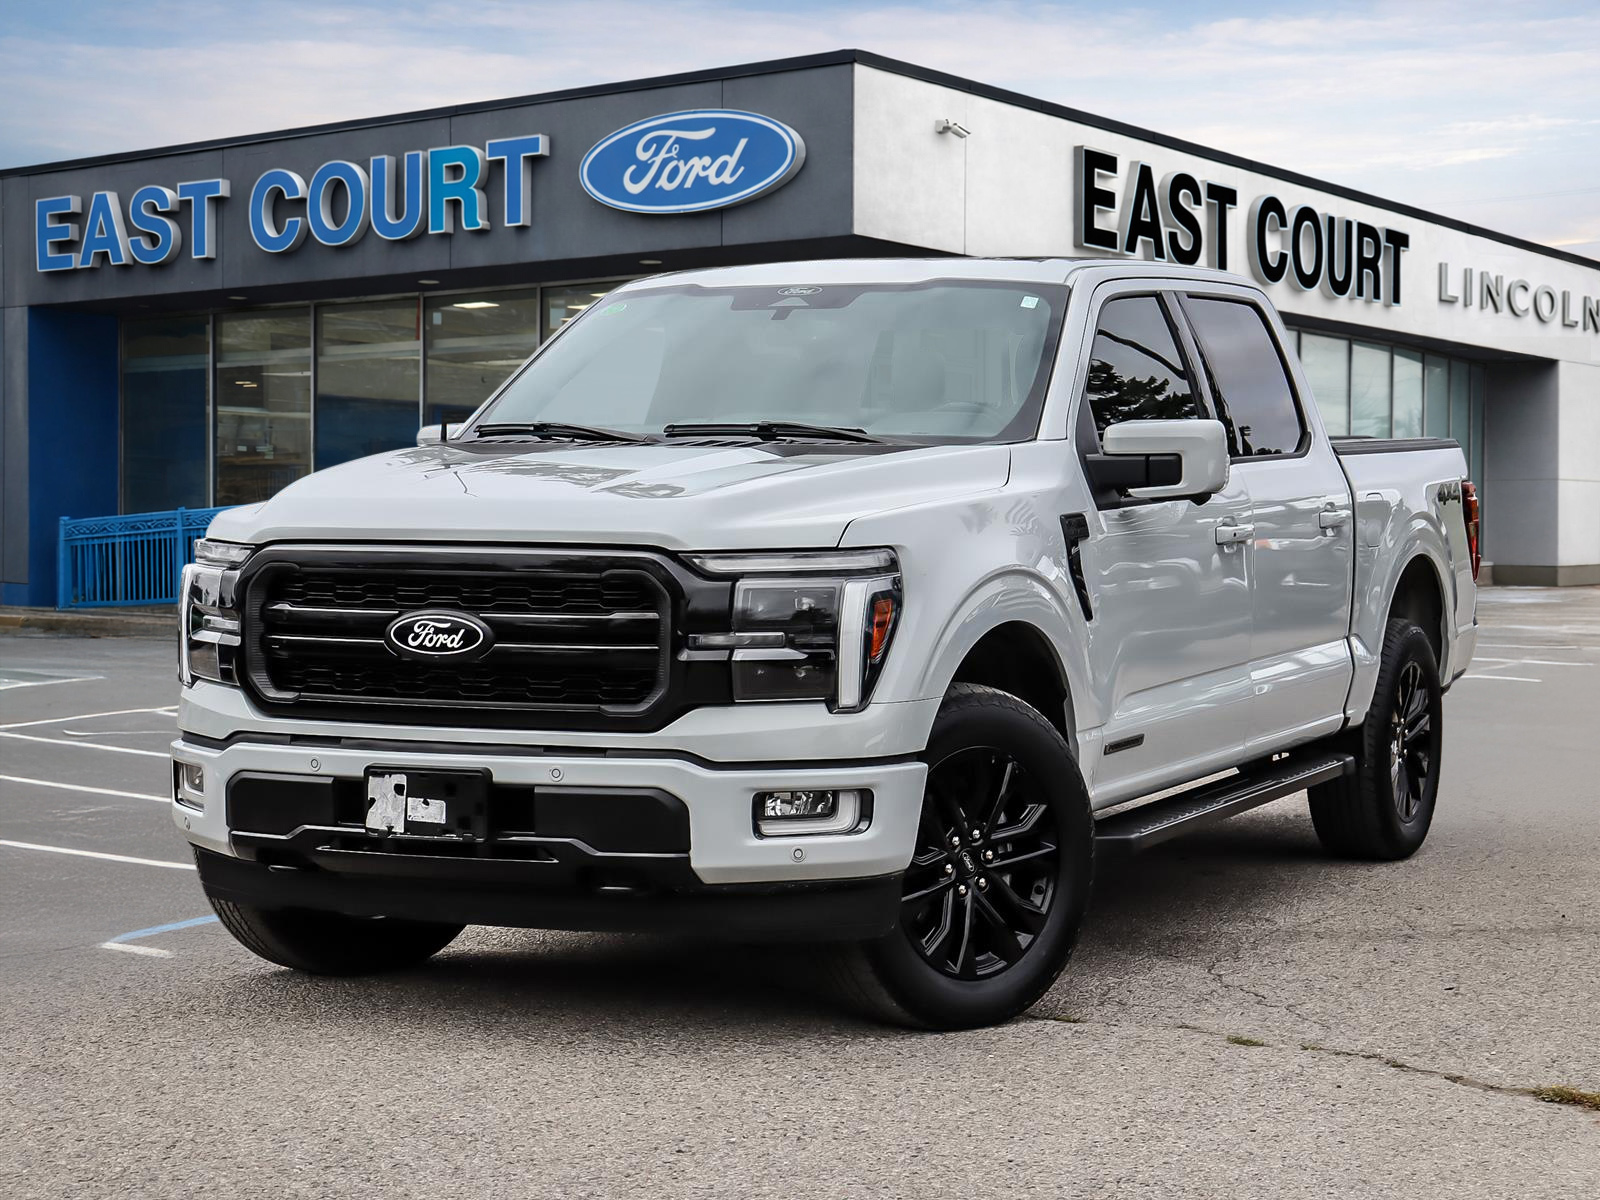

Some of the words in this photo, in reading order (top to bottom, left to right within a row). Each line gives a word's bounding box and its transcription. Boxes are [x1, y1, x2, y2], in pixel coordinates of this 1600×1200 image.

[623, 127, 749, 195] Ford
[36, 178, 230, 272] EAST
[249, 134, 550, 253] COURT
[1073, 145, 1238, 271] EAST
[1248, 193, 1410, 307] COURT
[1438, 262, 1600, 334] LINCOLN
[407, 620, 466, 649] Ford
